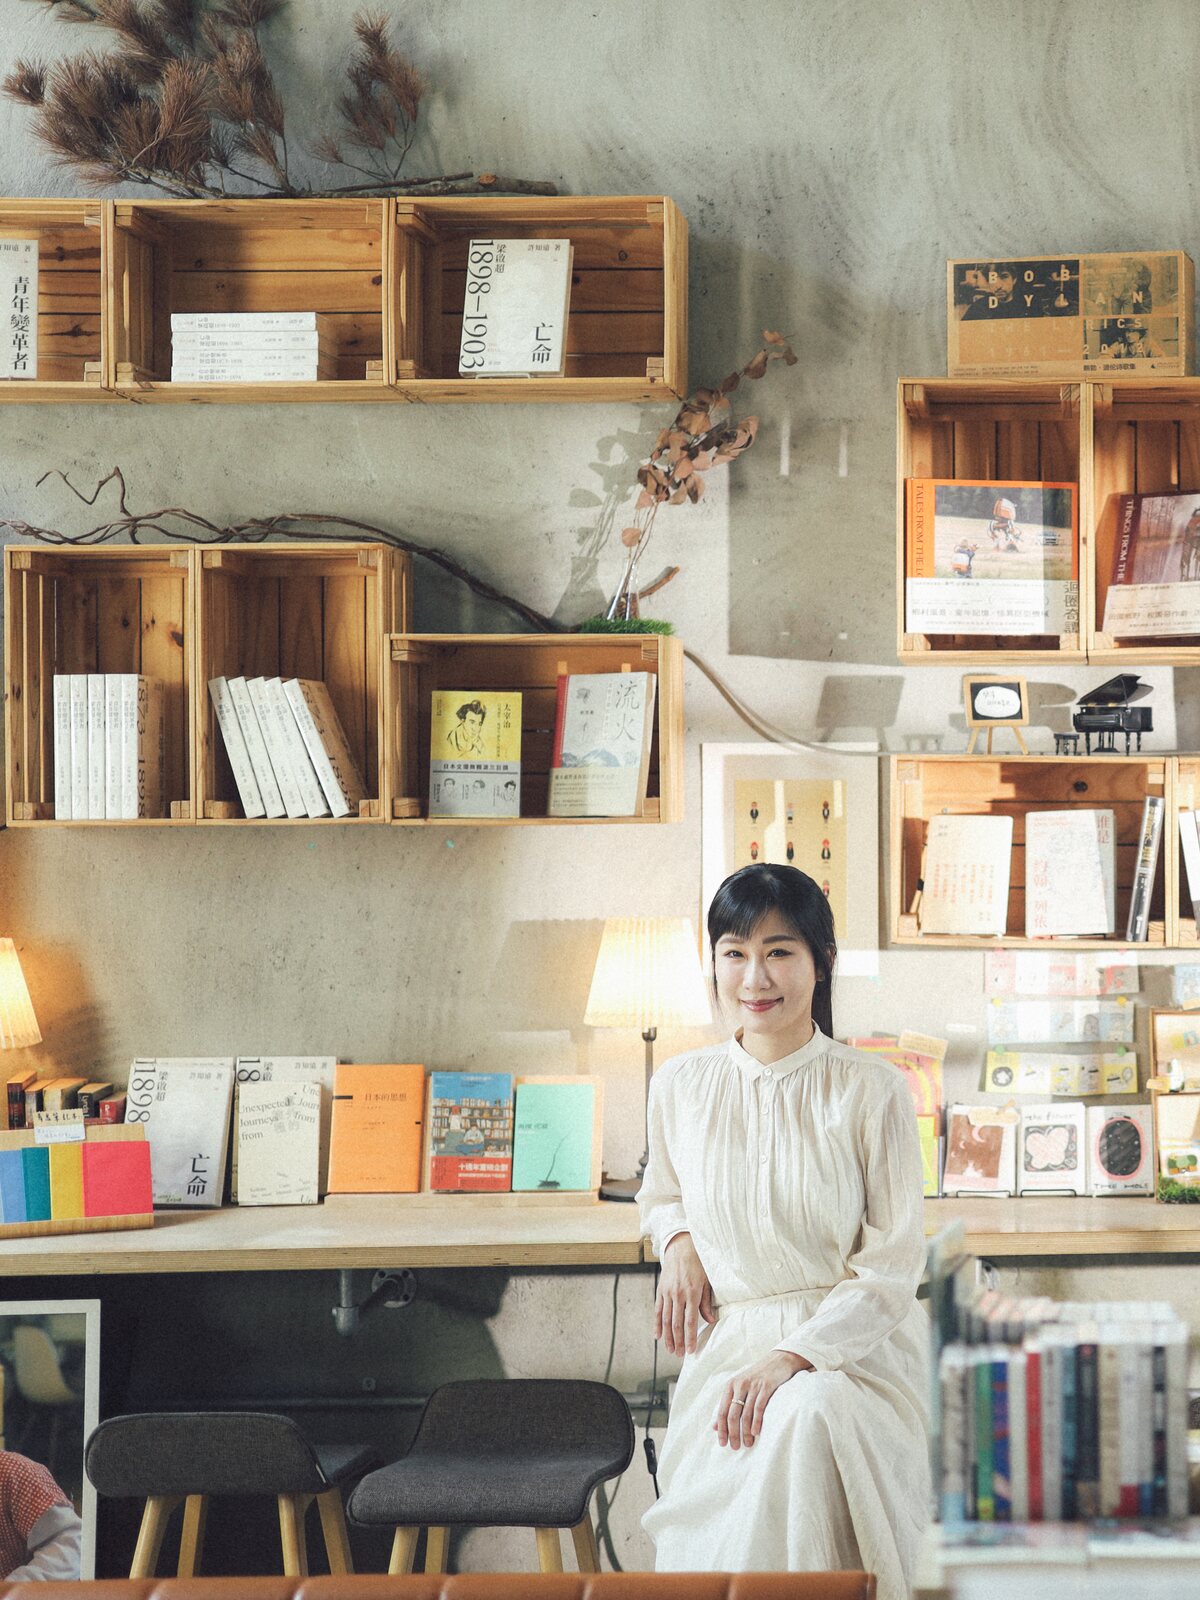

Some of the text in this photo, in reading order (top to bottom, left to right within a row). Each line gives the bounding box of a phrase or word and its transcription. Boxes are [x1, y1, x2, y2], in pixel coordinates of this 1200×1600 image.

[10, 275, 30, 371] 青年變革者
[532, 322, 554, 364] 亡命
[915, 516, 924, 543] FROM
[502, 703, 511, 729] 太宰治
[364, 1092, 407, 1101] 日本的思想
[241, 1131, 264, 1141] from
[186, 1153, 210, 1197] 亡命
